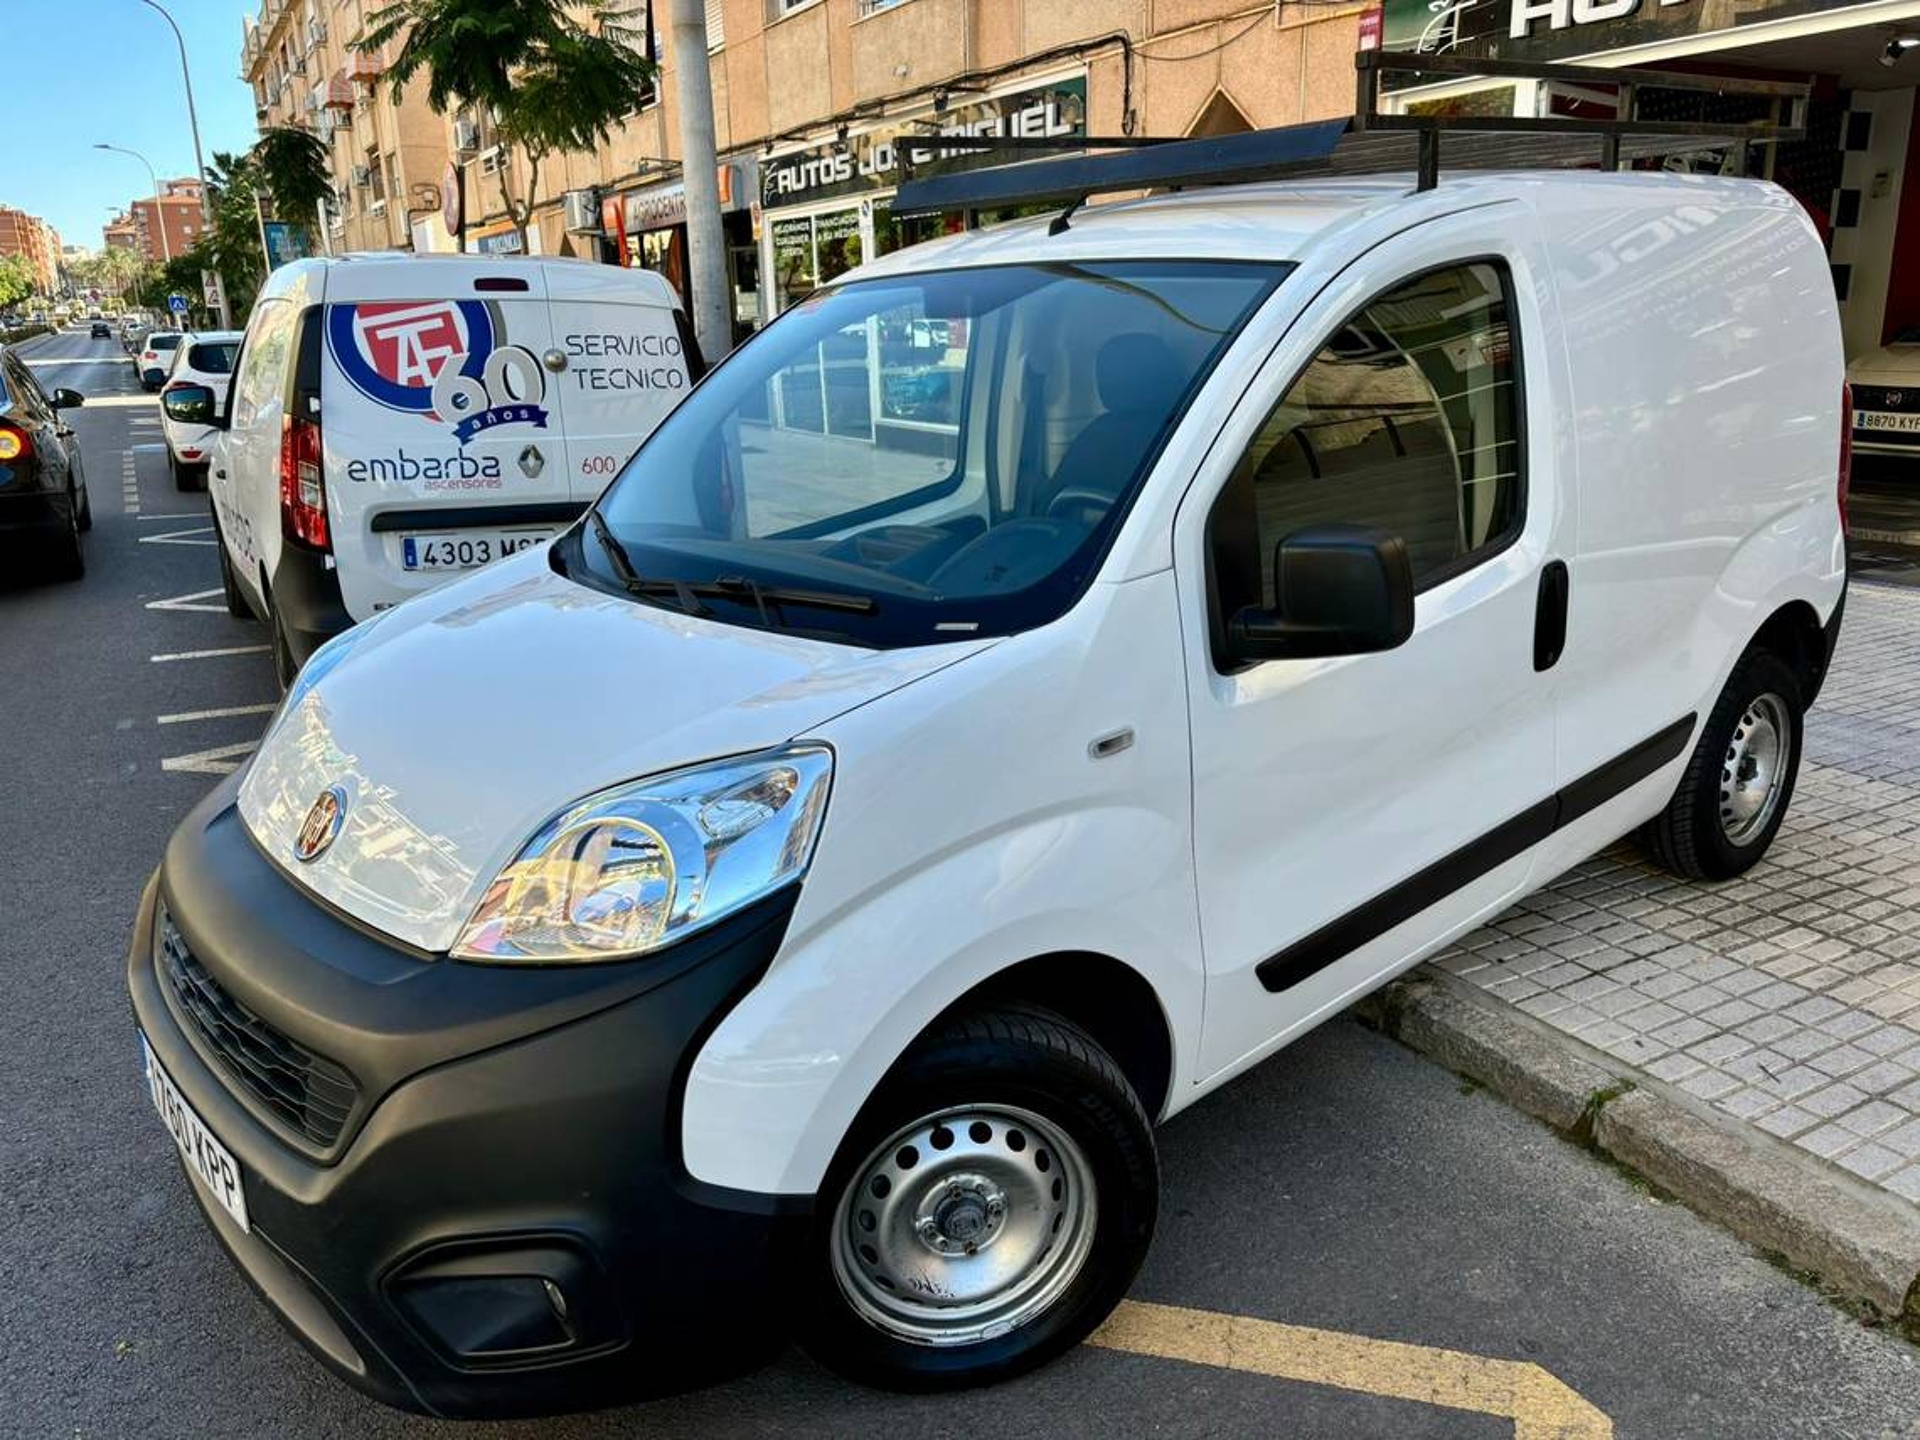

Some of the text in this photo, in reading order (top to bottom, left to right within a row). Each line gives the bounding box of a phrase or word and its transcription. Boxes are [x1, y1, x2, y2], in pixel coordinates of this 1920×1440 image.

[778, 156, 851, 194] AUTOS
[471, 406, 529, 431] años
[347, 447, 501, 482] embarba
[582, 455, 616, 474] 600
[423, 475, 502, 491] ascensores
[423, 540, 491, 566] 4303
